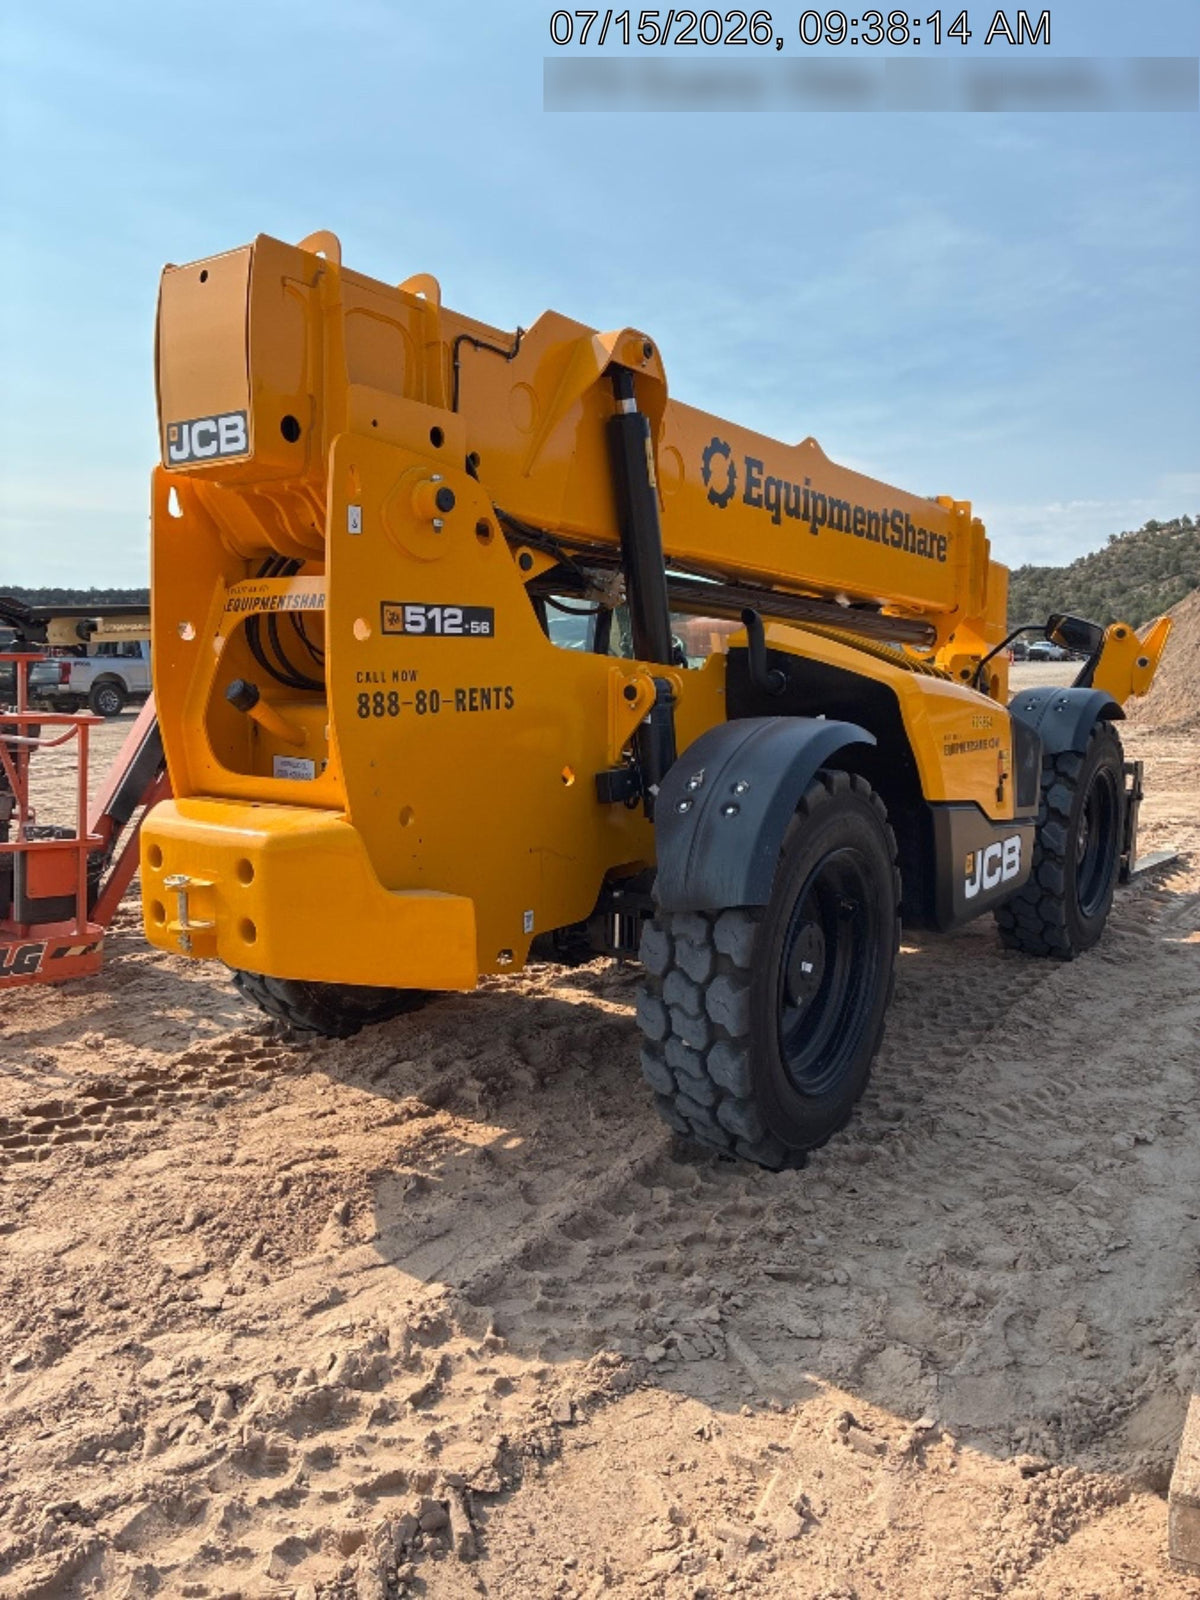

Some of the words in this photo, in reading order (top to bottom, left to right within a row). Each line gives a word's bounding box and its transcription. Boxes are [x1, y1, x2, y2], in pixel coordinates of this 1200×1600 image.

[169, 415, 248, 460] JCB
[742, 455, 947, 563] EquipmentShare
[356, 671, 387, 684] CALL
[392, 669, 418, 683] NOW
[357, 685, 515, 719] 888-80-RENTS
[964, 834, 1021, 899] JCB
